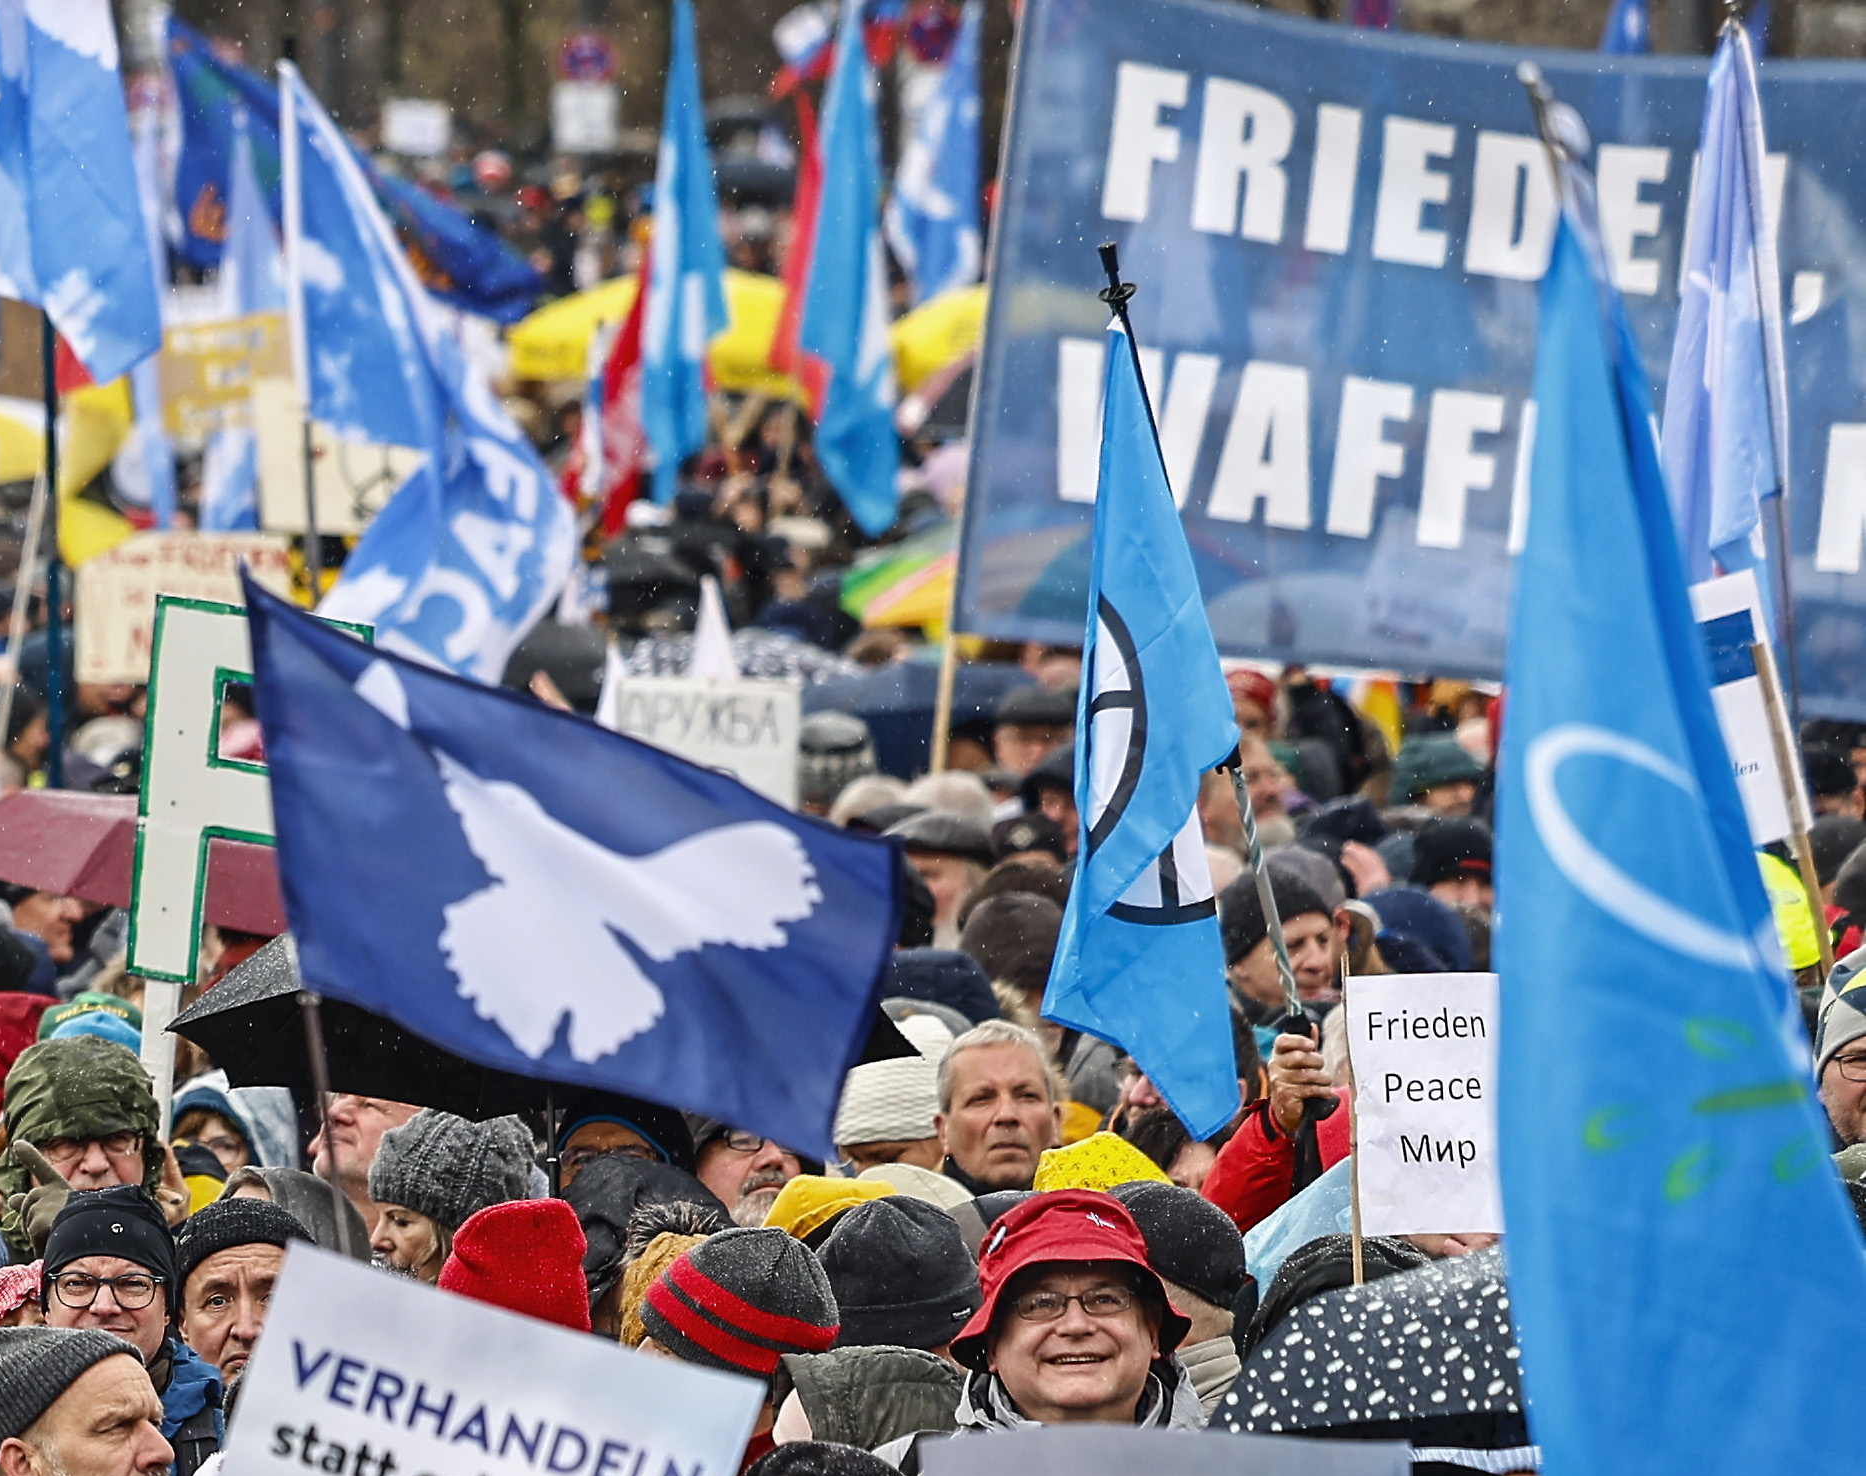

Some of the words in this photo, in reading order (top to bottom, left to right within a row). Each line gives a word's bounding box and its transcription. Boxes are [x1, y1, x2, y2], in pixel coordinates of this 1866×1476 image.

[1367, 1008, 1487, 1043] Frieden
[1383, 1071, 1483, 1103] Peace
[1400, 1133, 1478, 1171] Мир
